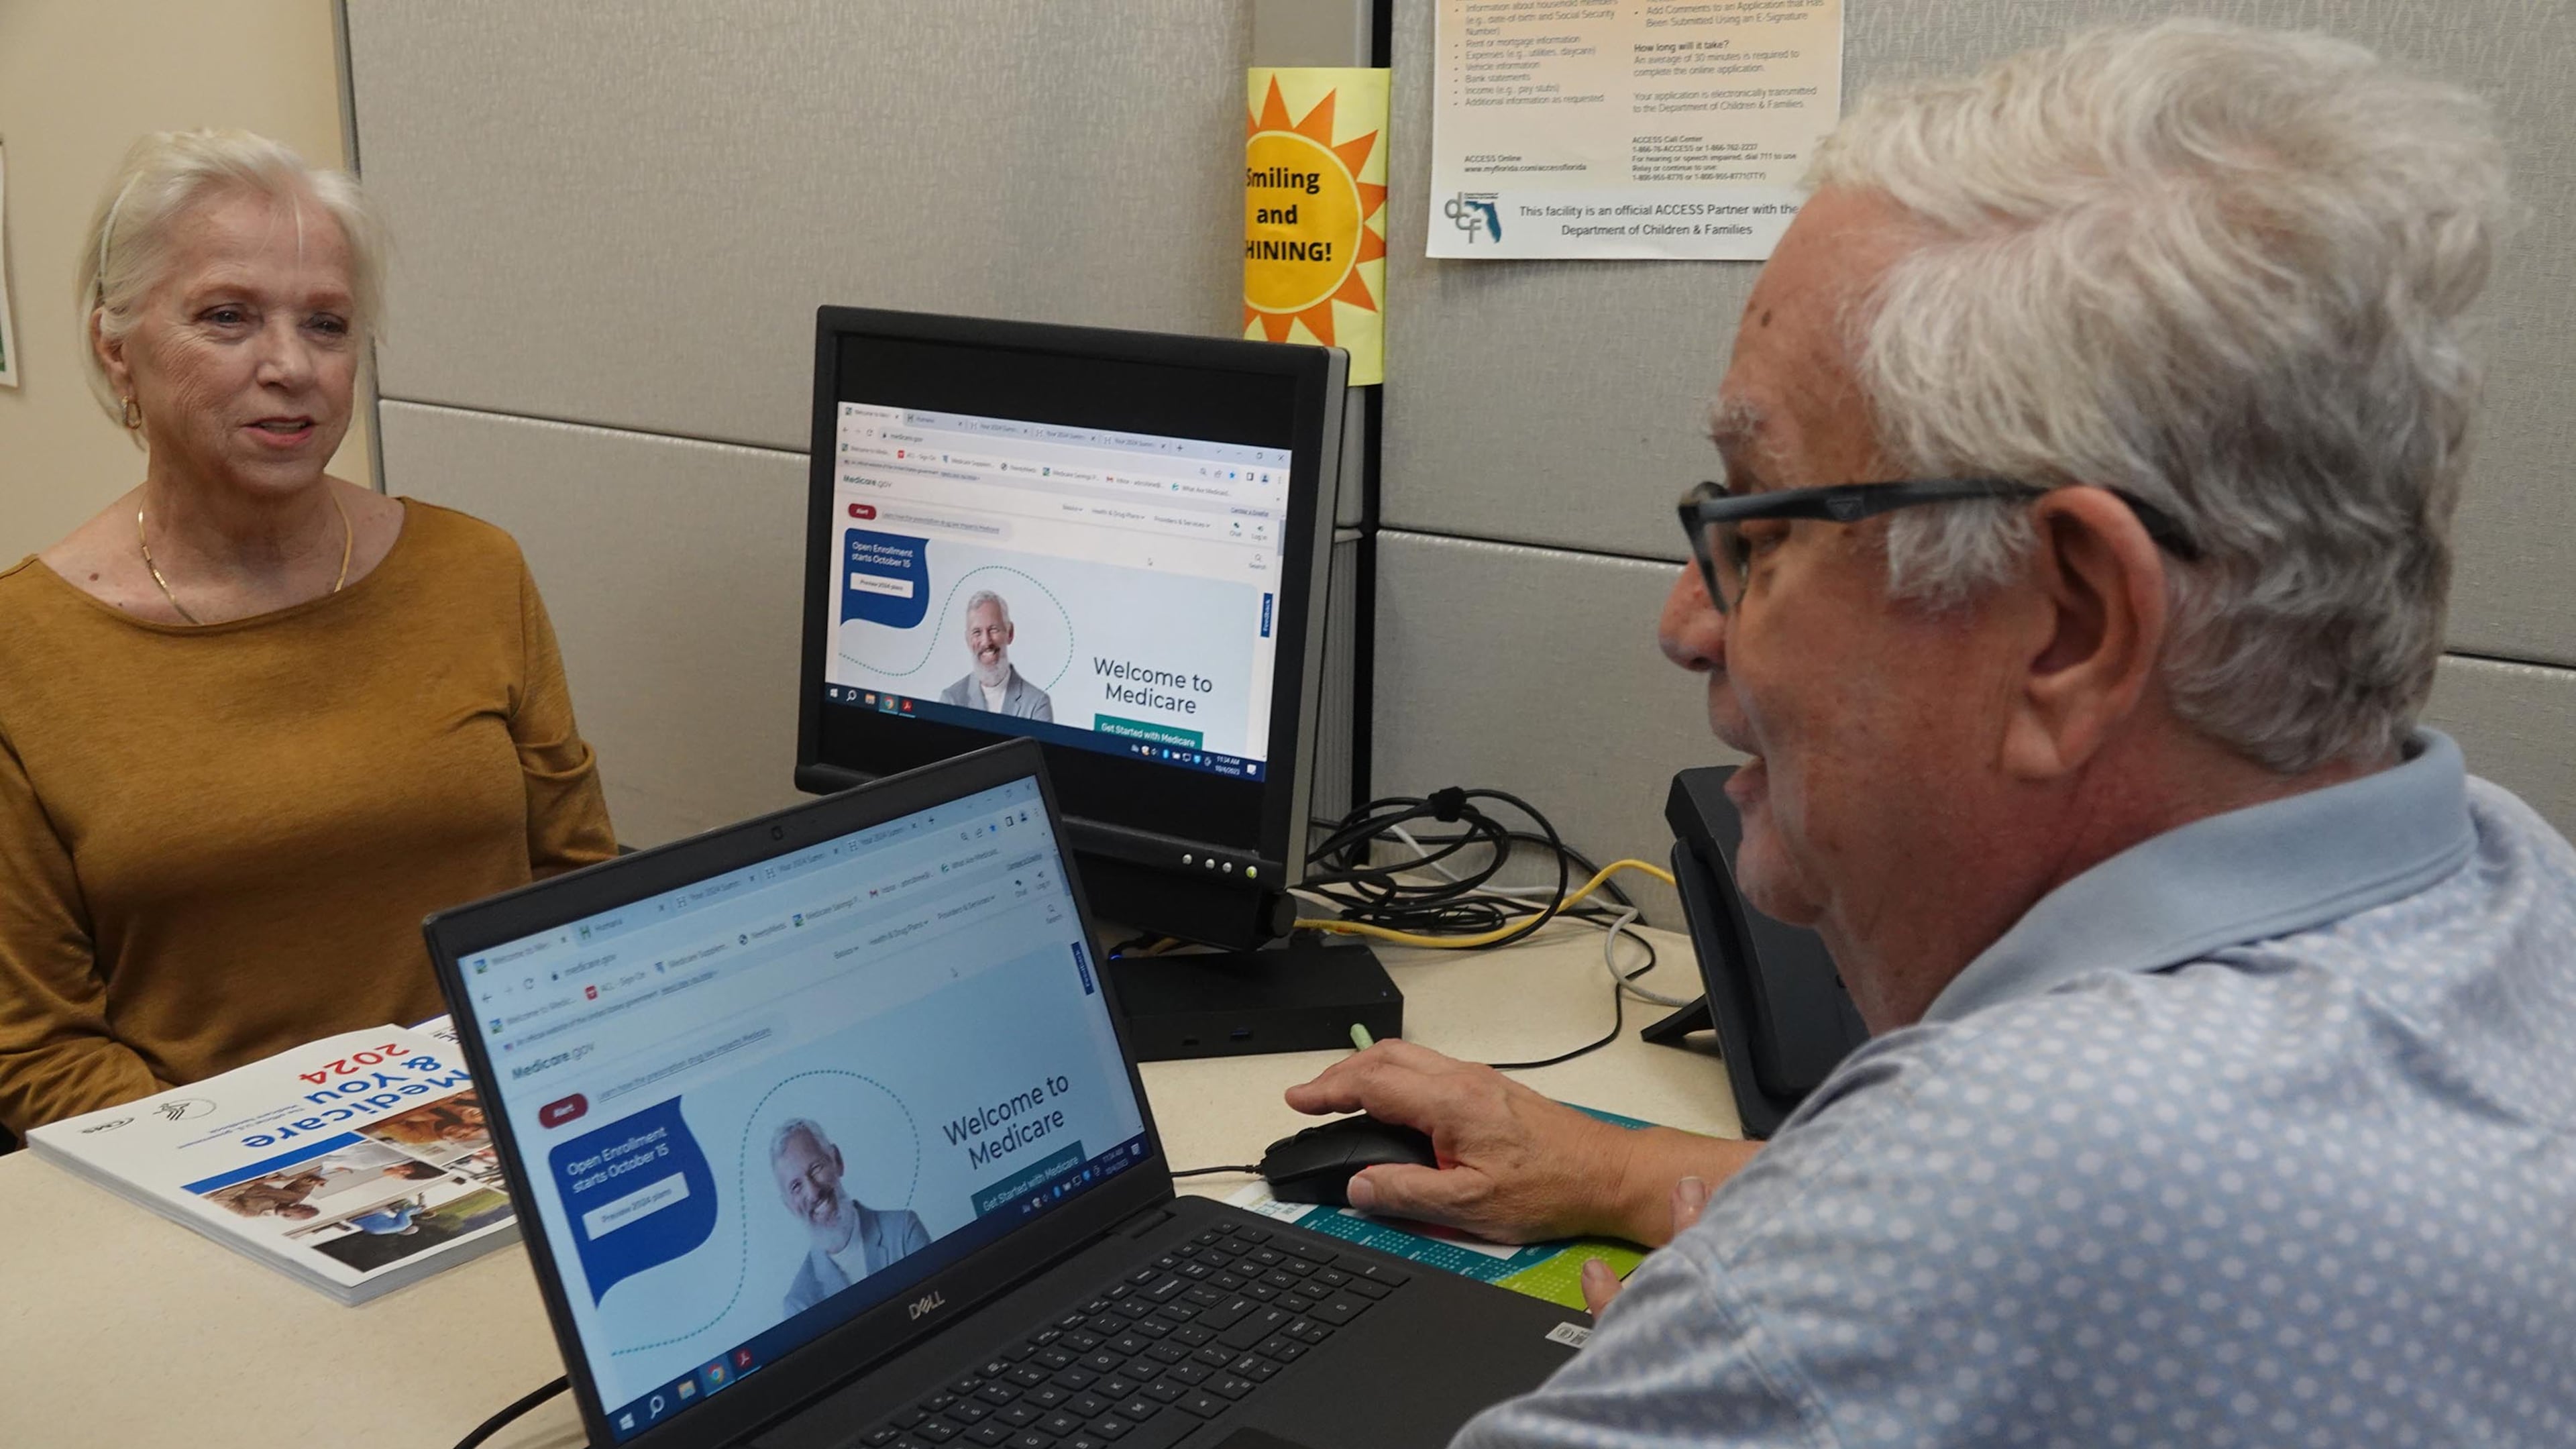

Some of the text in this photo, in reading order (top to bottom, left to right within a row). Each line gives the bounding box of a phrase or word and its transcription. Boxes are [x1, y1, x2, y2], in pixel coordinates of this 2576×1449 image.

[1556, 11, 1580, 20] Social
[1582, 10, 1615, 20] Security
[1665, 4, 1711, 14] Comments
[1713, 3, 1721, 11] to
[1716, 14, 1740, 25] Using
[1634, 40, 1729, 54] How long will it take?
[1791, 50, 1800, 58] to
[1674, 66, 1687, 75] the
[1689, 65, 1715, 74] online
[1633, 101, 1765, 113] to the Department of Children &
[1464, 154, 1521, 163] ACCESS Online
[1246, 167, 1320, 195] Smiling
[1256, 205, 1297, 225] and
[1520, 203, 1799, 219] This facility is an official ACCESS Partner with the
[1562, 223, 1753, 237] Department of Children & Families
[1244, 241, 1332, 262] HINING!
[852, 541, 914, 558] Open Enrollment
[851, 553, 912, 568] starts October 15
[1093, 657, 1213, 693] Welcome to
[1106, 682, 1196, 714] Medicare
[1101, 722, 1195, 747] Get Started with Medicare
[299, 1043, 412, 1086] 2024
[512, 1041, 595, 1080] Medicare.gov
[304, 1056, 443, 1105] & You
[240, 1069, 471, 1148] Medicare
[553, 1104, 575, 1118] Alert
[943, 1075, 1069, 1146] Welcome to
[969, 1109, 1065, 1170] Medicare
[566, 1127, 668, 1175] Open Enrollment
[572, 1143, 669, 1194] starts October 15
[982, 1156, 1079, 1212] Get Started with Medicare
[909, 1291, 945, 1321] DELL
